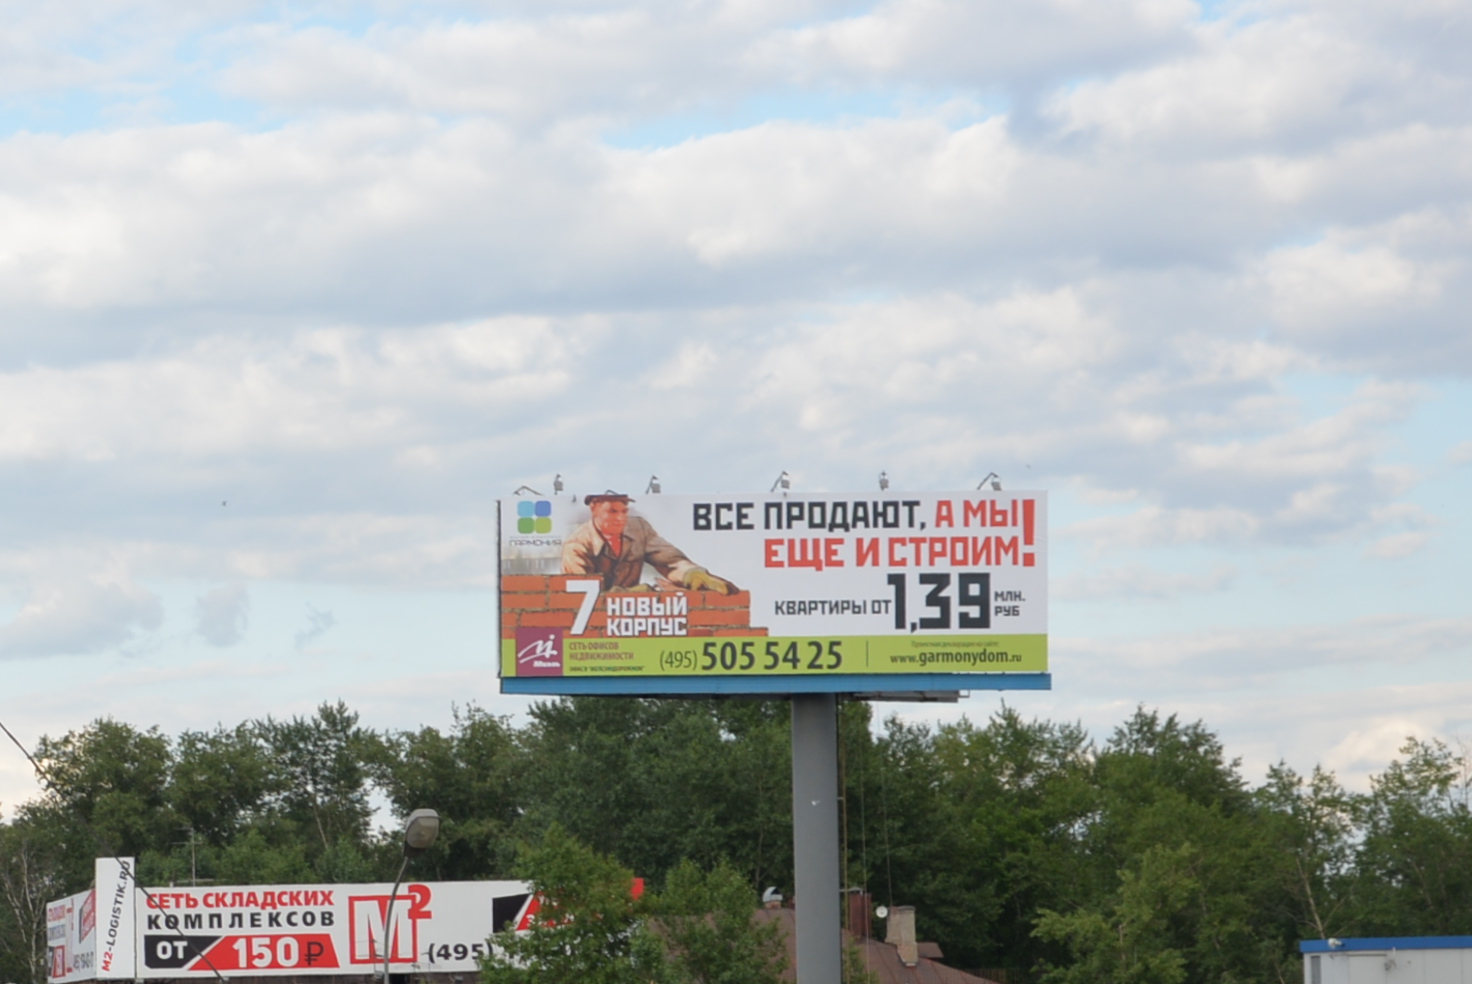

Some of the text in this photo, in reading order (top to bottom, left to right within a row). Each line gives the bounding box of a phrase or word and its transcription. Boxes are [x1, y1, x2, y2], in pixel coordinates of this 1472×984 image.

[693, 502, 755, 531] ВСЕ
[764, 500, 926, 532] ПРОДАЮТ,
[935, 500, 954, 528] А
[764, 537, 845, 571] ЕЩЕ
[856, 537, 880, 567] И
[566, 579, 601, 635] 7
[606, 592, 688, 616] НОВЫЙ
[775, 573, 991, 633] КВАРТИРЫ ОТ 1,39
[994, 591, 1026, 602] МЛН.
[994, 605, 1020, 617] РУБ
[606, 617, 688, 637] КОРПУС
[569, 641, 619, 651] СЕТЬ ОФИСОВ
[569, 652, 634, 661] НЕДВИЖИМОСТИ
[659, 641, 843, 672] (495) 505 54 25
[890, 648, 1022, 667] www.garmonydom.ru
[146, 890, 335, 910] СЕТЬ СКЛАДСКИХ
[147, 910, 335, 931] КОМПЛЕКСОВ
[156, 940, 189, 960] ОТ
[232, 936, 300, 969] 150
